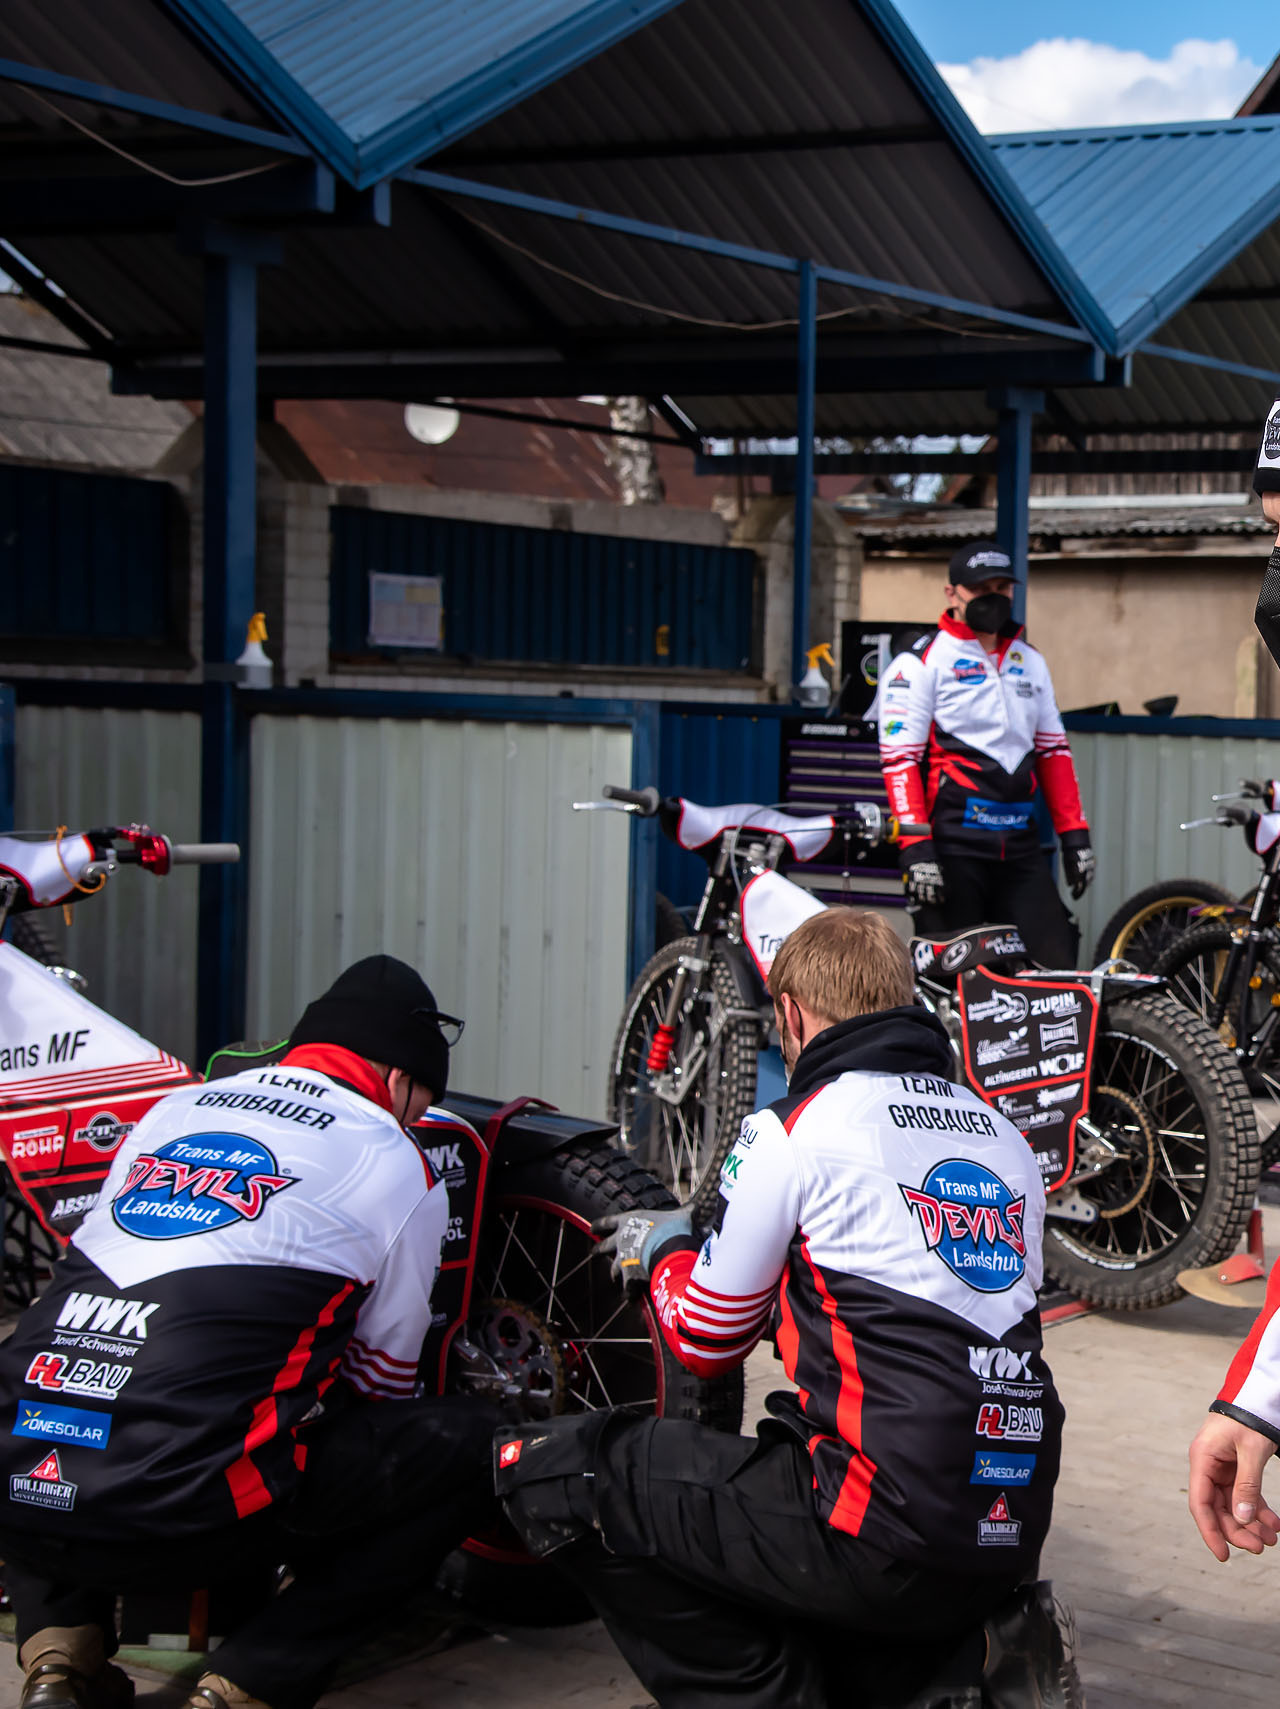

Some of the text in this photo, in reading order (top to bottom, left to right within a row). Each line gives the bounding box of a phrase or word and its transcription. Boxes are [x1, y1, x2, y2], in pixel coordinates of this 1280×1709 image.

[1030, 992, 1077, 1016] ZUPIN
[47, 1029, 90, 1064] MF
[1039, 1052, 1085, 1077] WOLF
[900, 1075, 955, 1099] TEAM
[195, 1091, 336, 1131] GROBAUER
[888, 1104, 998, 1138] GROBAUER
[171, 1143, 266, 1168] Trans MF
[115, 1155, 303, 1221] DEVILS
[936, 1177, 1001, 1199] Trans MF
[120, 1197, 221, 1226] Landshut
[898, 1182, 1026, 1259] DEVILS
[954, 1247, 1020, 1272] Landshut
[56, 1292, 161, 1339] WWK
[79, 1336, 139, 1358] Schwaiger
[28, 1417, 103, 1441] ONESOLAR
[983, 1466, 1030, 1479] ONESOLAR
